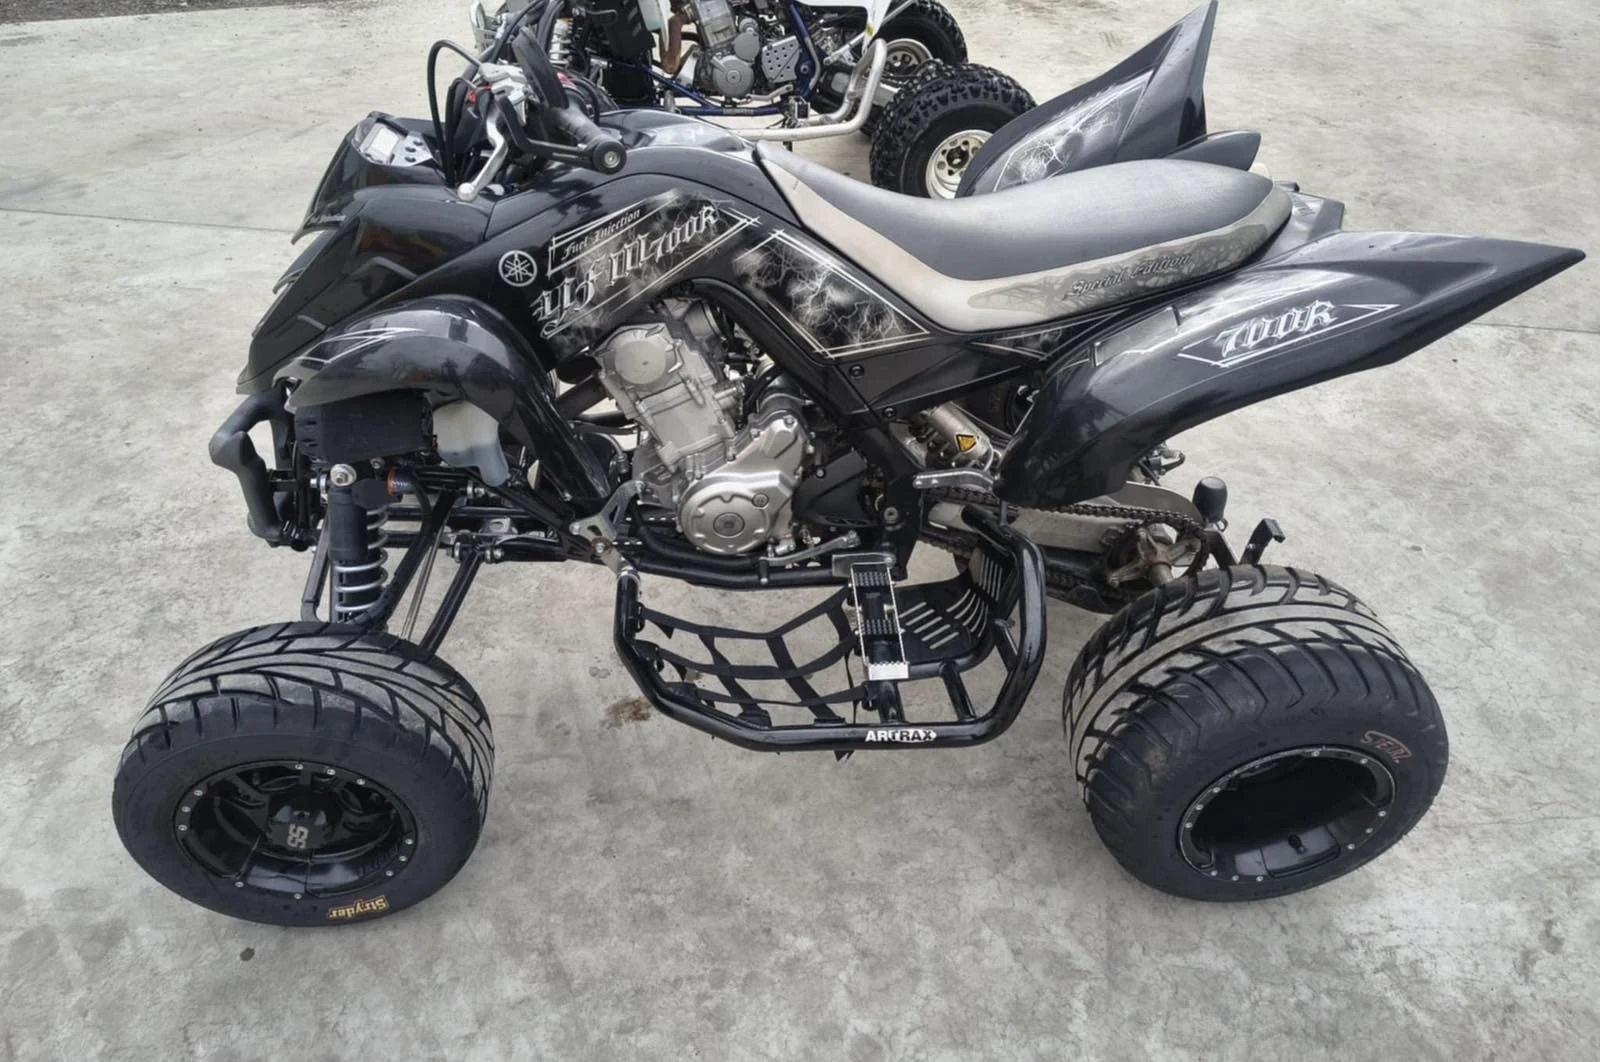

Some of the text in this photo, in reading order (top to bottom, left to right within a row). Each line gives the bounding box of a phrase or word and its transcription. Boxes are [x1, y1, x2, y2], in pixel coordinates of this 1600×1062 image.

[561, 209, 640, 260] Fuel Injection
[1214, 299, 1338, 358] 700R
[329, 897, 387, 919] Stryder
